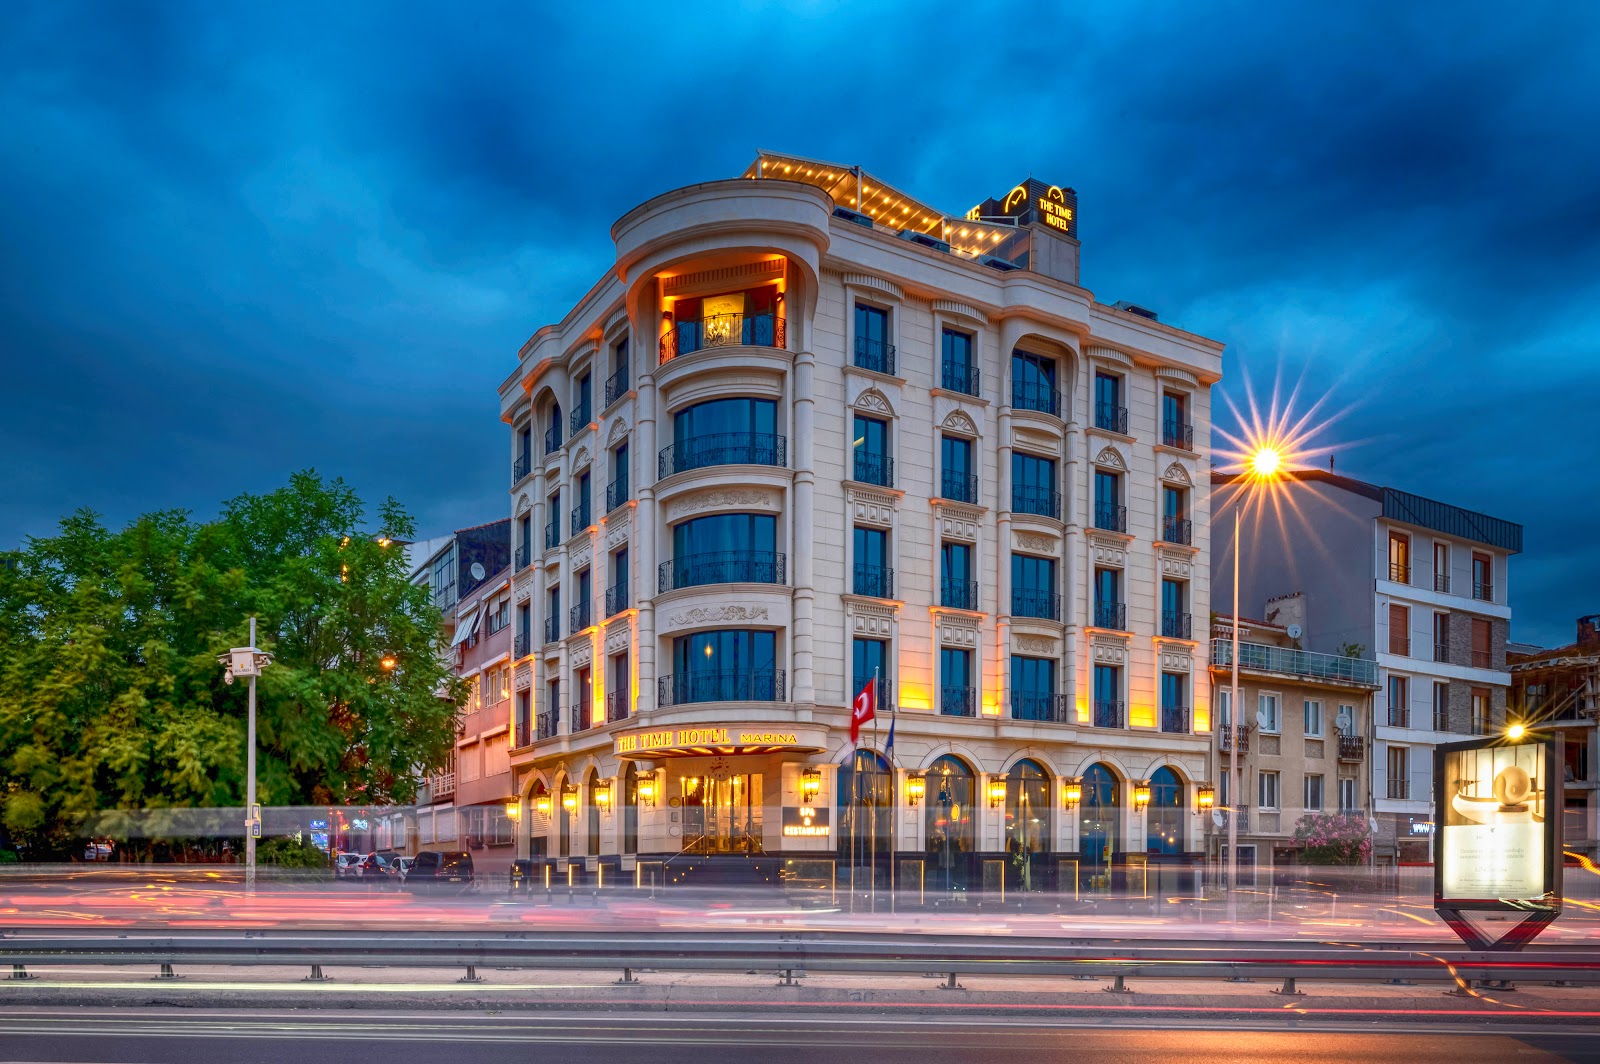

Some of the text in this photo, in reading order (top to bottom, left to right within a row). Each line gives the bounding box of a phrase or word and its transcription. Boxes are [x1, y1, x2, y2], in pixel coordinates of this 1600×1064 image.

[1039, 198, 1072, 220] THE TIME
[1046, 213, 1068, 231] HOTEL
[618, 736, 636, 752] THE
[640, 732, 672, 748] TIME
[678, 729, 730, 745] HOTEL
[799, 807, 815, 817] SPA
[804, 817, 811, 826] &
[784, 826, 830, 836] RESTAURANT
